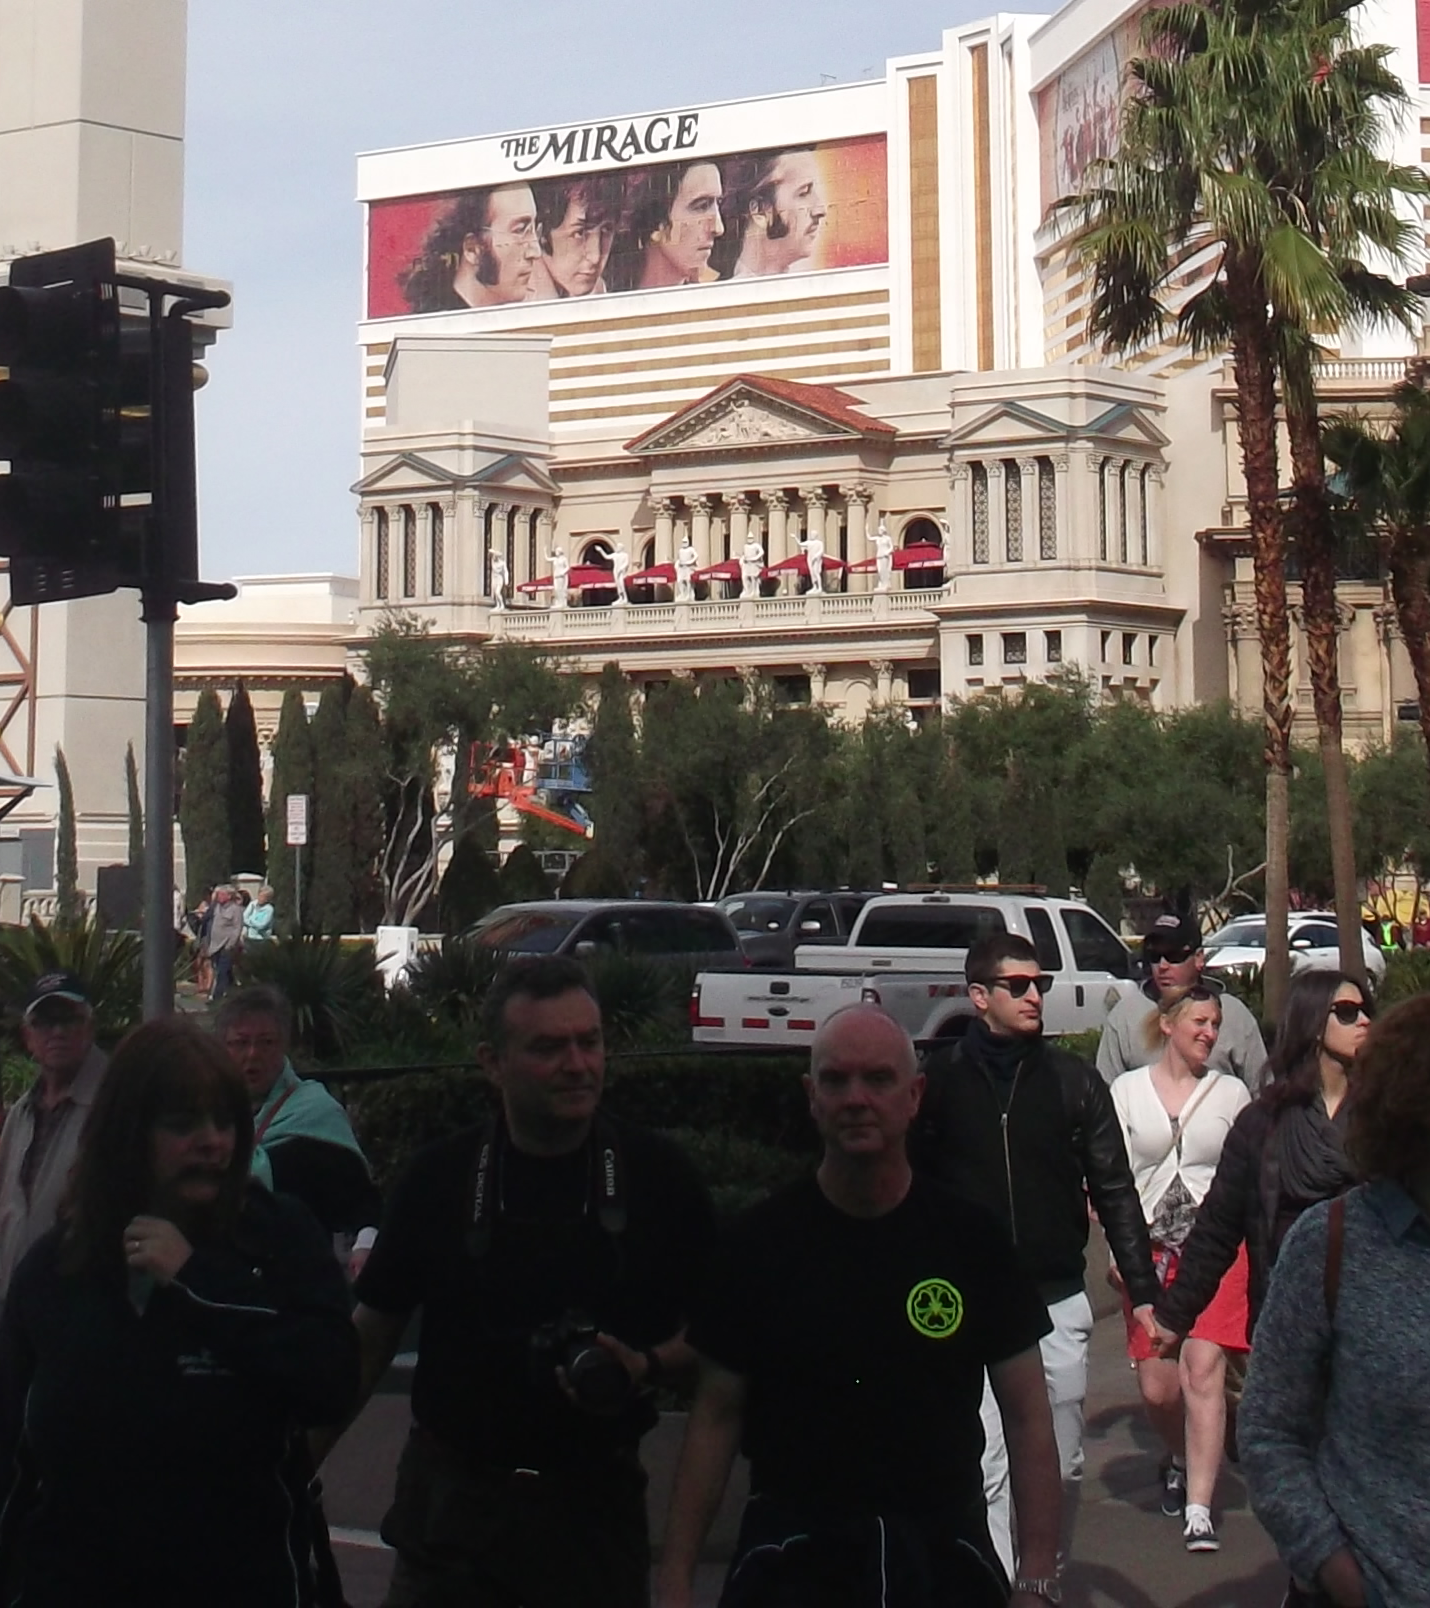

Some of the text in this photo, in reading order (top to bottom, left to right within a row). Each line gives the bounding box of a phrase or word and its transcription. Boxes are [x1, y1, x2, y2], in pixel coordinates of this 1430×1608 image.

[500, 113, 700, 172] THE MIRAGE
[604, 1148, 615, 1196] Canon
